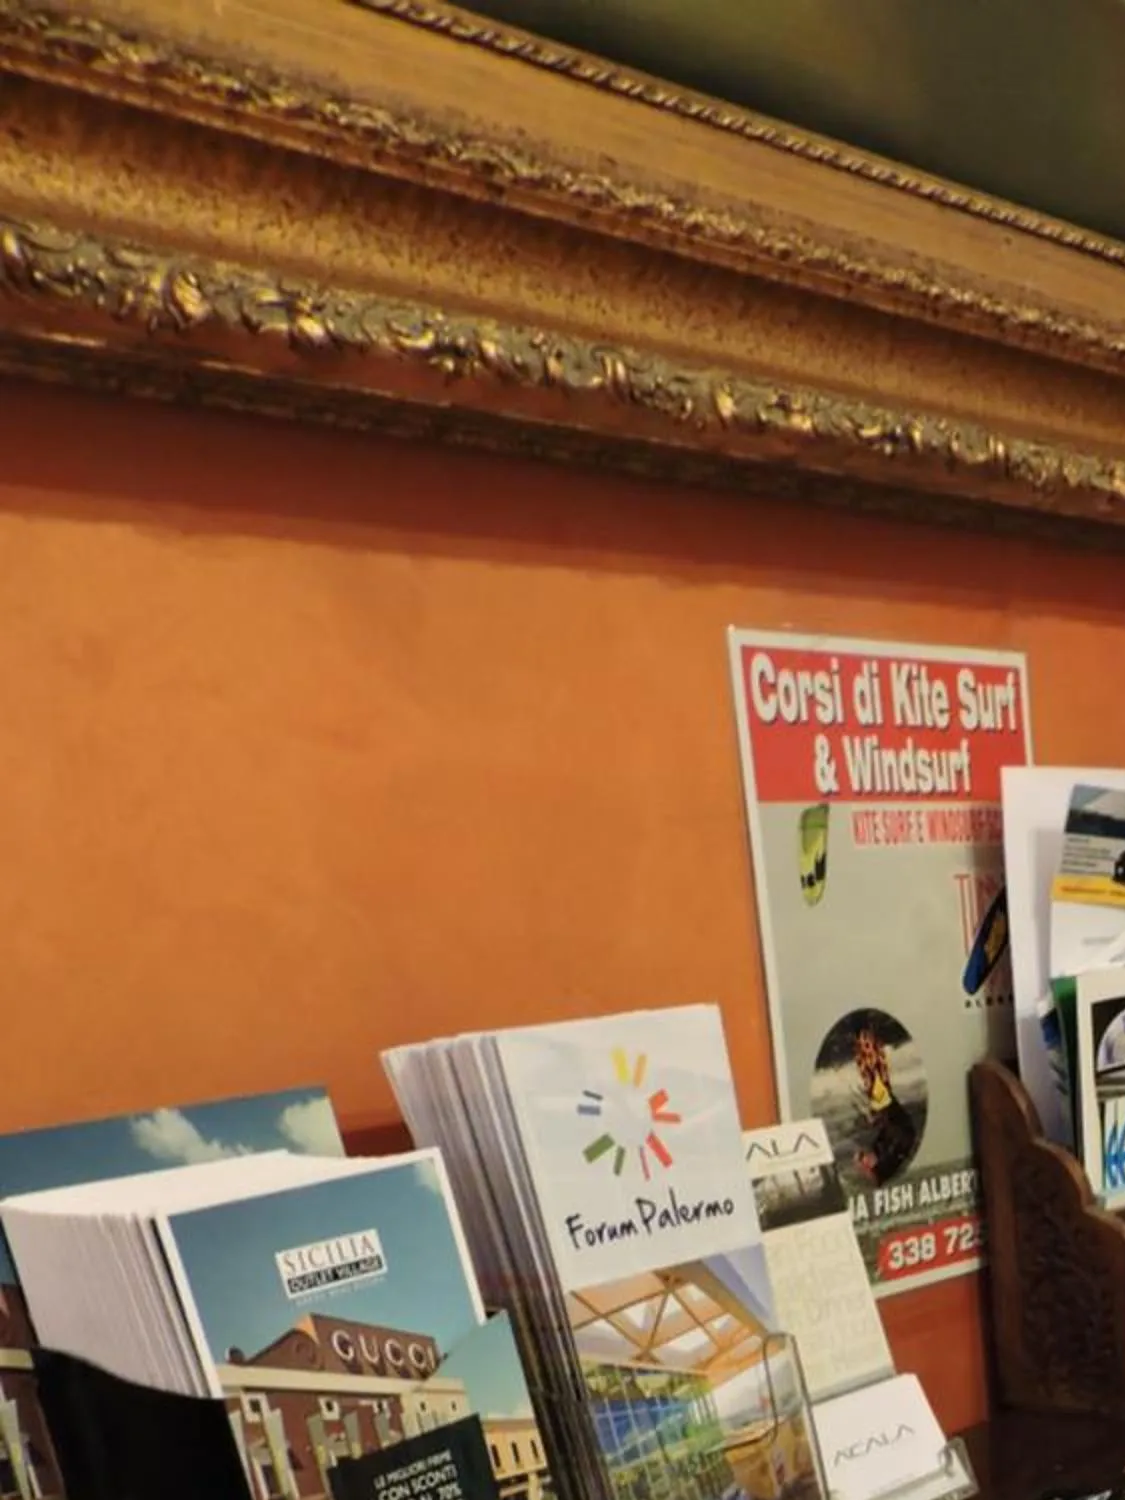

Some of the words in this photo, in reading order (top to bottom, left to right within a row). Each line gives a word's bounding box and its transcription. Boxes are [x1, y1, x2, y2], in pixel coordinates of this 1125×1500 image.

[750, 652, 844, 724] Corsi
[853, 660, 883, 726] di
[890, 661, 951, 729] Kite
[958, 667, 1019, 731] Surf
[814, 733, 839, 794] &
[843, 735, 972, 794] Windsurf
[873, 1184, 914, 1217] FISH
[919, 1168, 978, 1204] ALBER
[565, 1212, 639, 1251] Forum
[635, 1185, 735, 1236] Palermo
[282, 1234, 376, 1277] SICILIA
[887, 1231, 937, 1270] 338
[331, 1329, 436, 1371] GUCCI
[411, 1463, 459, 1495] SCONTI
